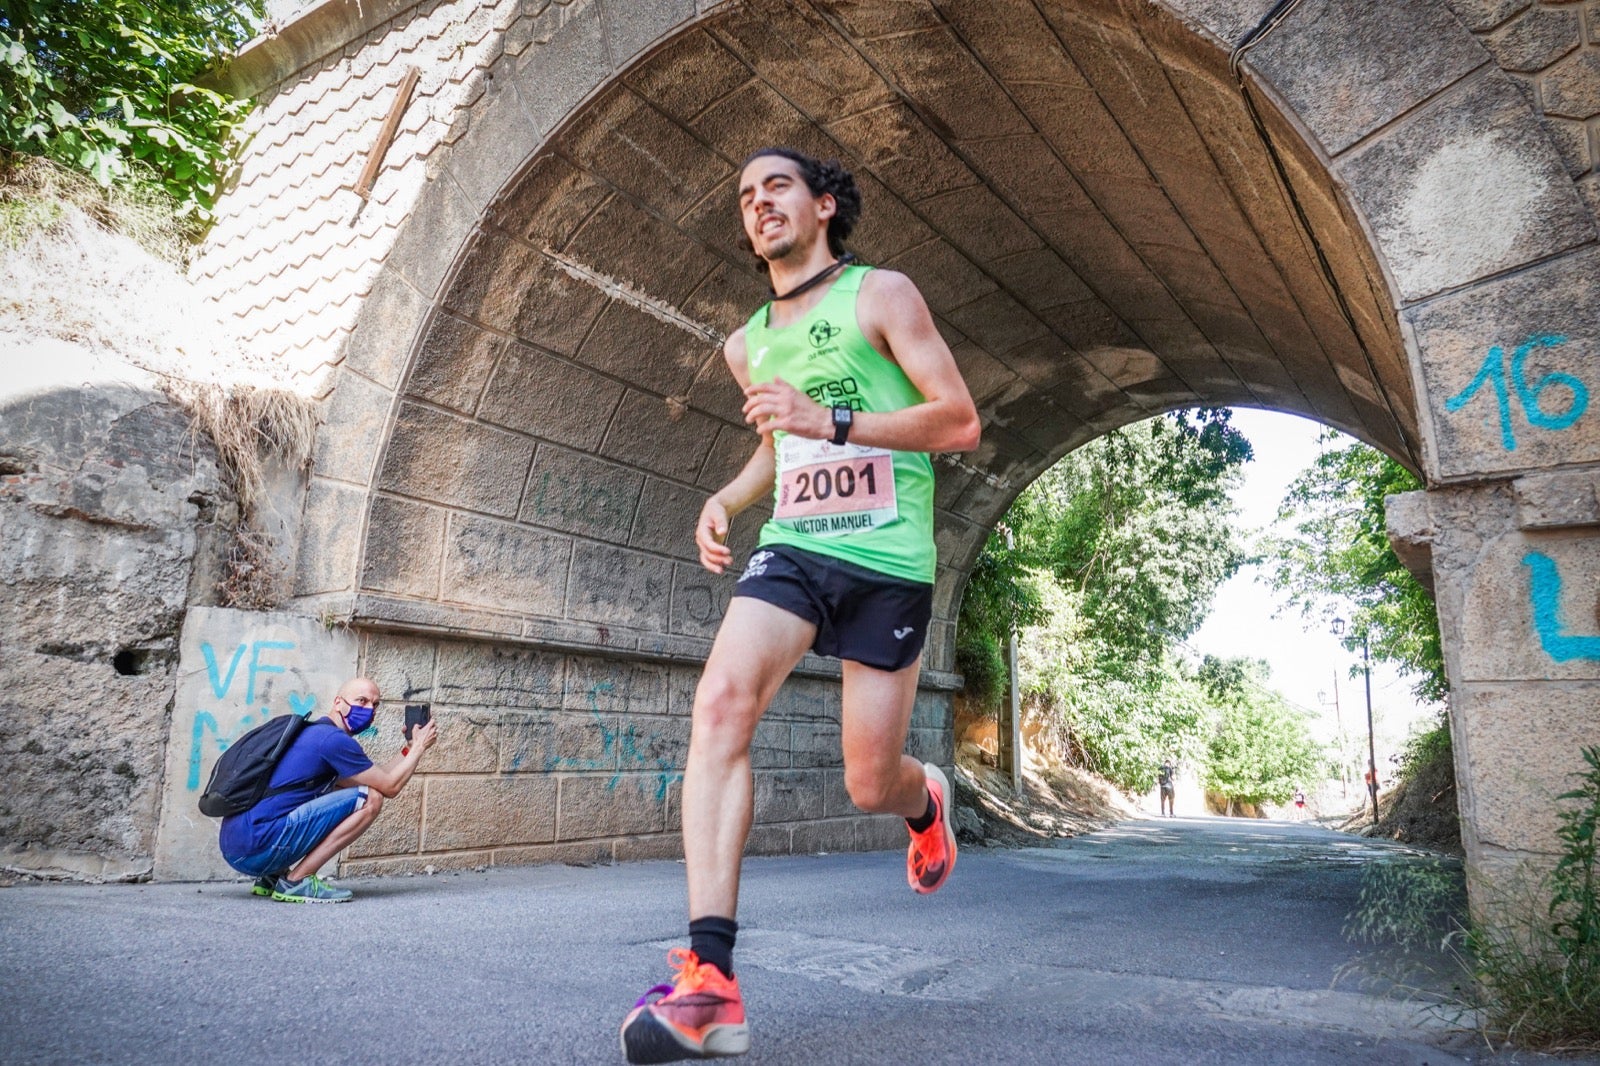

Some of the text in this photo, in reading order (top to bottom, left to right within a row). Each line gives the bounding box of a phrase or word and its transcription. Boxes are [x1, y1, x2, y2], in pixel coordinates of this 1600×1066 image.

[1445, 334, 1590, 452] 16
[794, 463, 877, 504] 2001
[831, 514, 875, 531] MANUEL
[200, 640, 295, 705] VF
